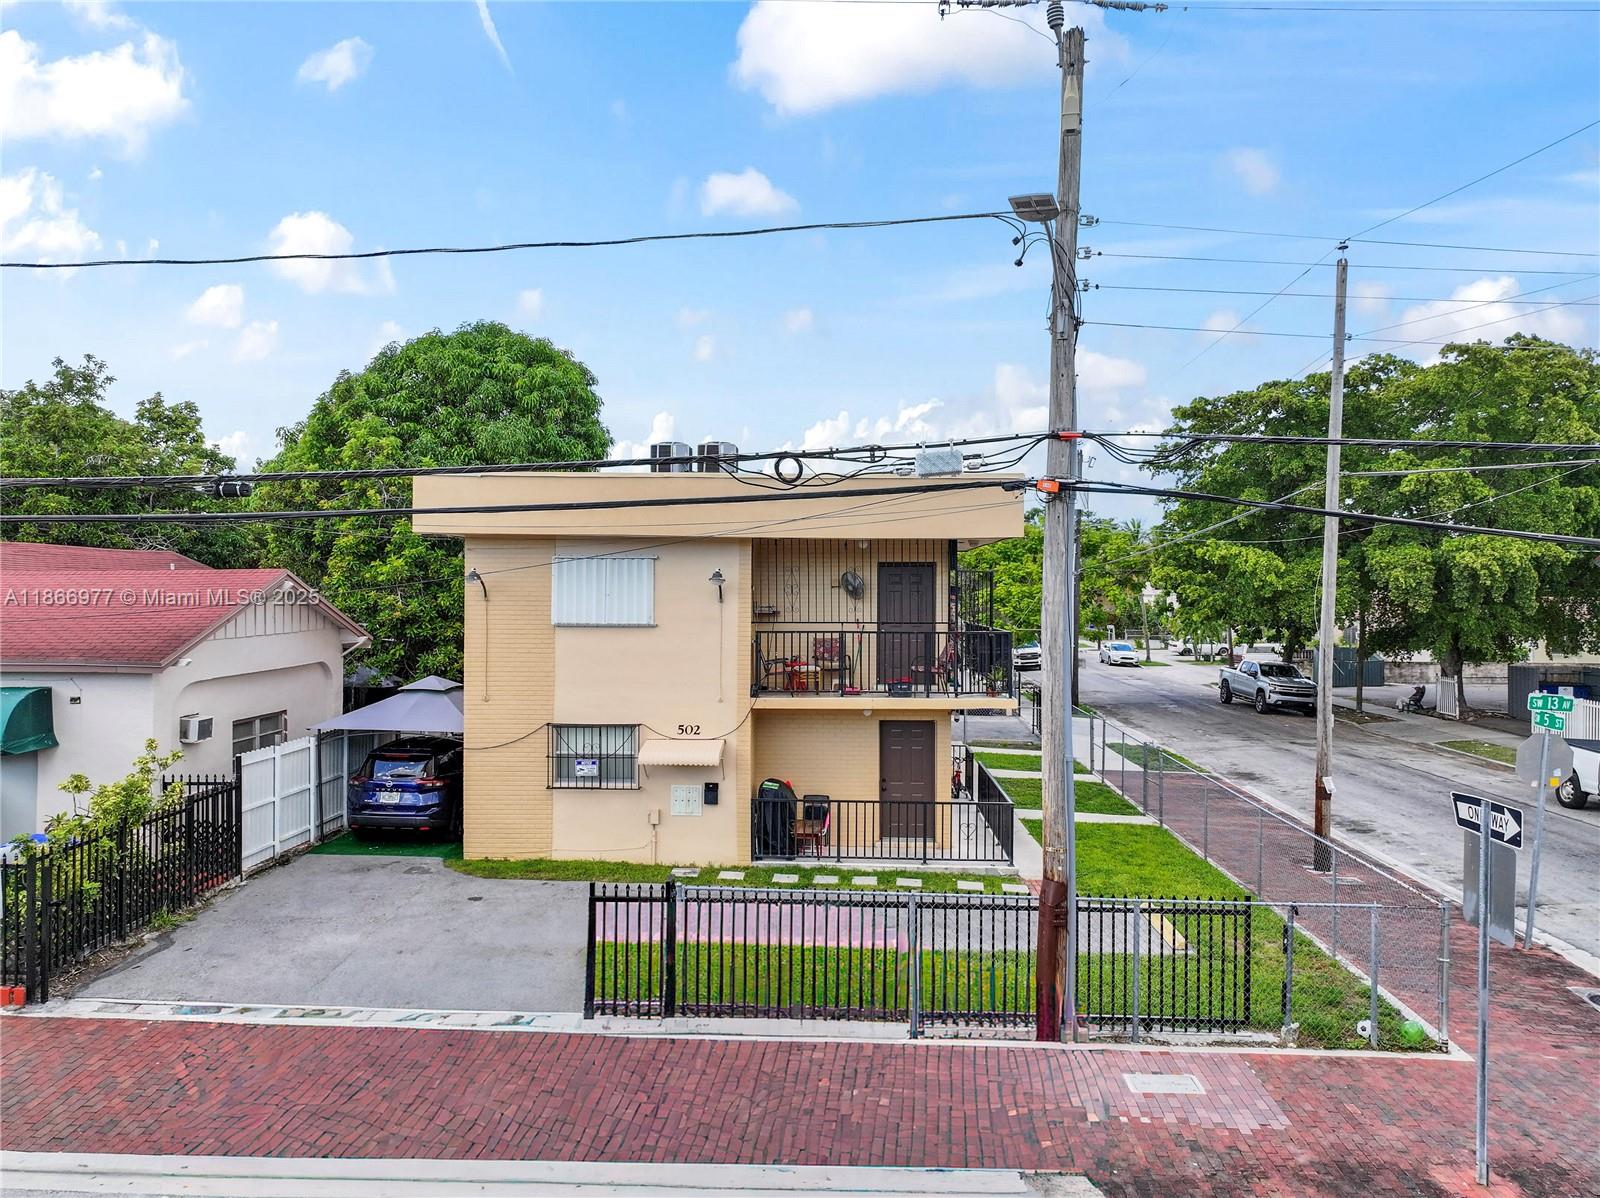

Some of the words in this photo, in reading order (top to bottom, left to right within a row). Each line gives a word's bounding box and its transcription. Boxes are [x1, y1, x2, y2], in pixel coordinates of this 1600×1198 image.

[1532, 698, 1543, 708] SW
[1547, 697, 1559, 710] 13
[1543, 713, 1550, 726] 5
[1555, 718, 1563, 728] ST
[677, 724, 701, 735] 502
[1467, 806, 1481, 822] ON
[1491, 814, 1509, 832] WAY
